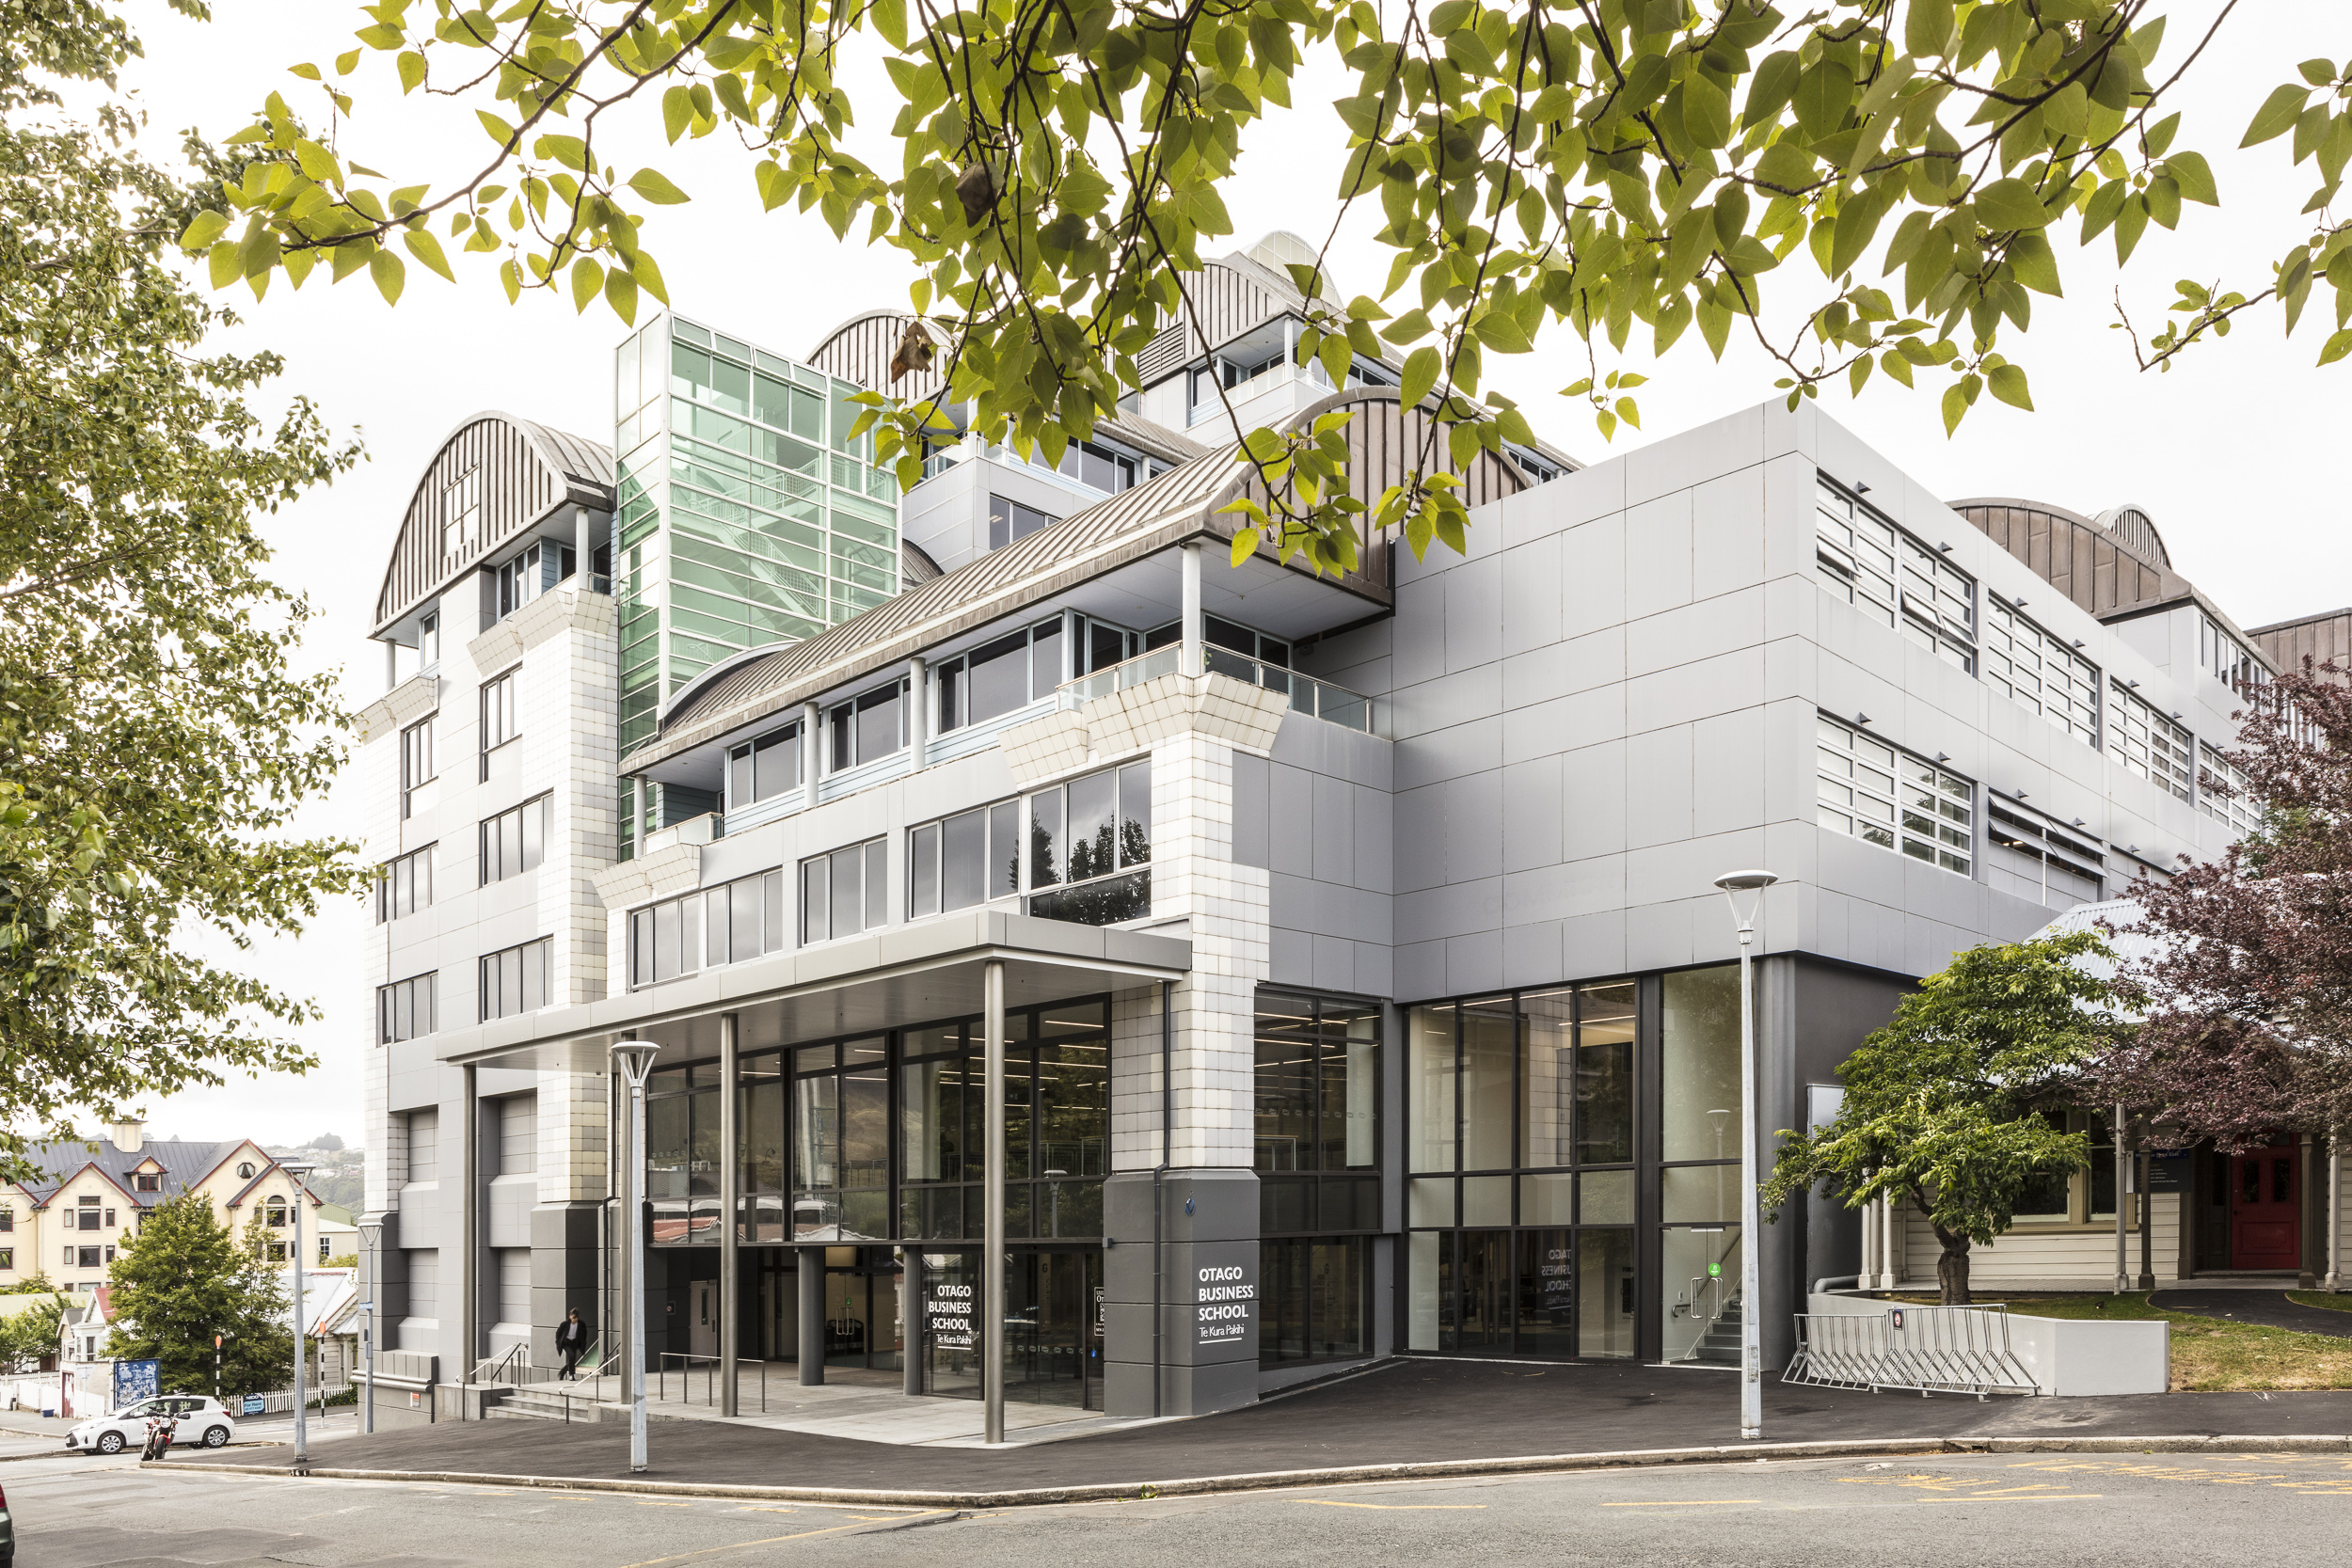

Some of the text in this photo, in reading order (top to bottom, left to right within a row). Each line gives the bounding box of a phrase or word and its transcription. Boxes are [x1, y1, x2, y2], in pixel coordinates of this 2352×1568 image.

[1199, 1266, 1243, 1282] OTAGO
[937, 1285, 971, 1297] OTAGO
[1199, 1285, 1254, 1302] BUSINESS
[929, 1301, 971, 1313] BUSINESS
[1199, 1305, 1249, 1322] SCHOOL
[932, 1318, 971, 1330] SCHOOL
[1199, 1327, 1208, 1338] Te
[1209, 1326, 1225, 1337] Kura
[936, 1334, 944, 1343] Te
[944, 1334, 957, 1344] Kura
[2006, 1458, 2352, 1490] VEHICLE
